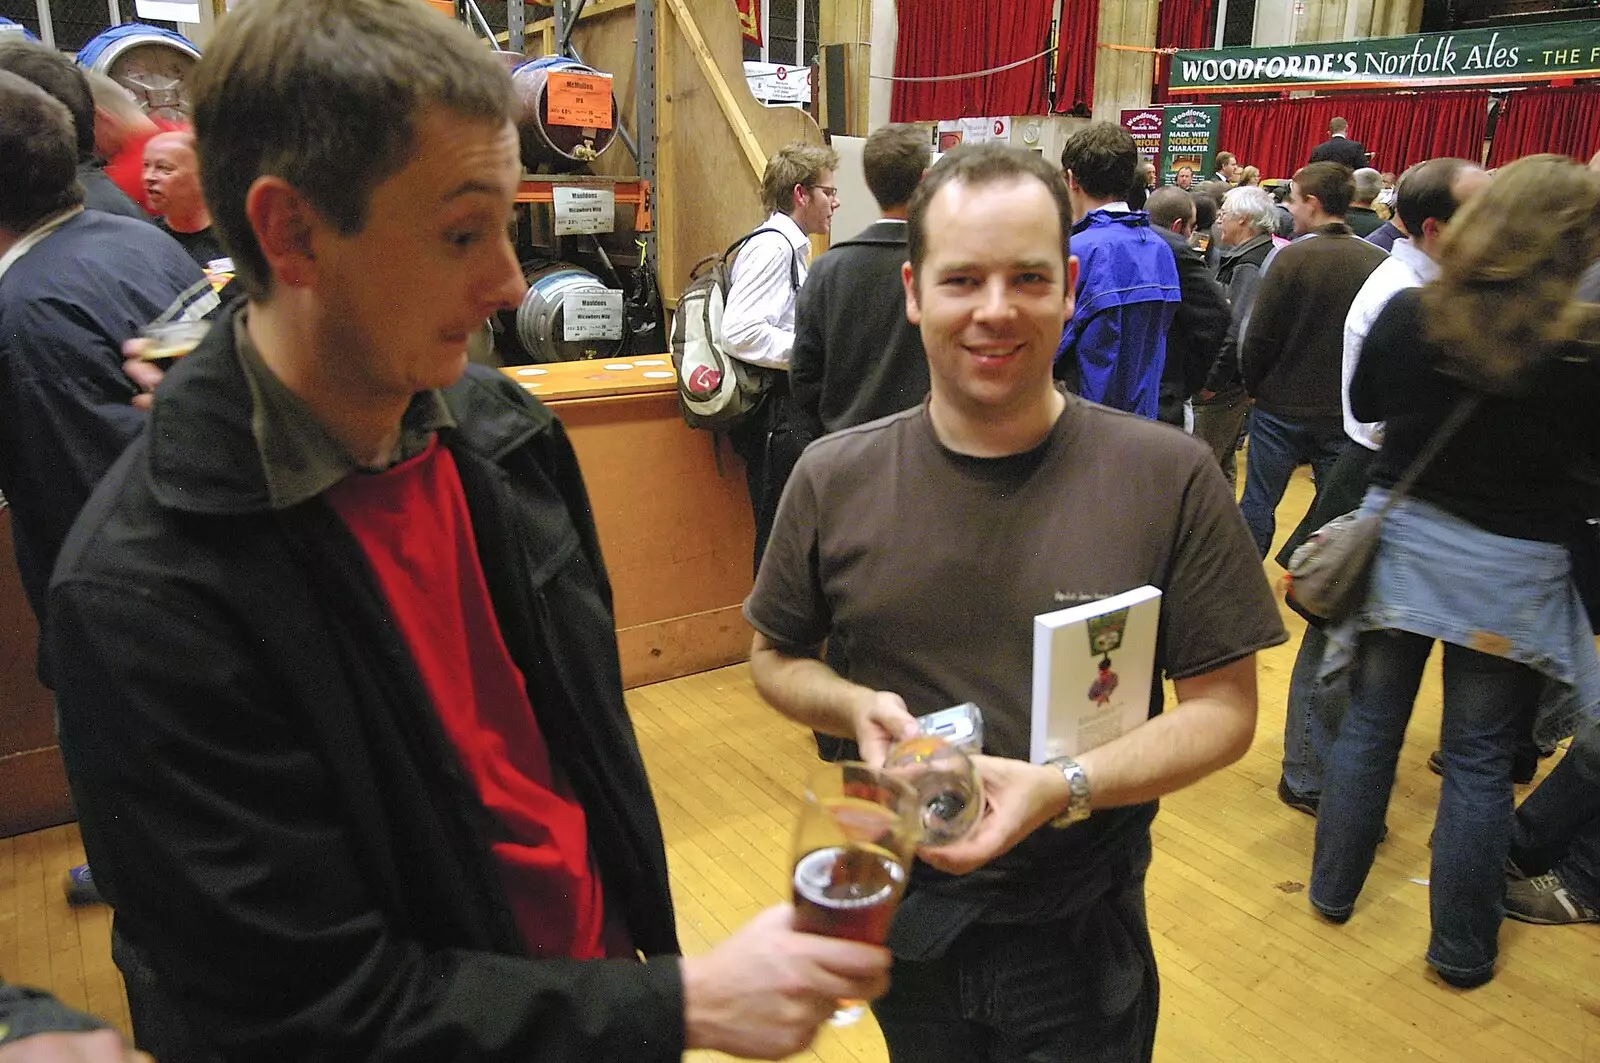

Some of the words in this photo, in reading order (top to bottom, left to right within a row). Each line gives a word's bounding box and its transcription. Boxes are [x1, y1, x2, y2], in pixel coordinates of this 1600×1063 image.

[1182, 52, 1357, 82] WOODFORDE'S
[1362, 36, 1456, 77] Norfolk
[1461, 32, 1519, 70] Ales
[1543, 48, 1580, 65] THE
[1126, 112, 1162, 126] Woodforde's
[1170, 109, 1210, 124] Woodforde's
